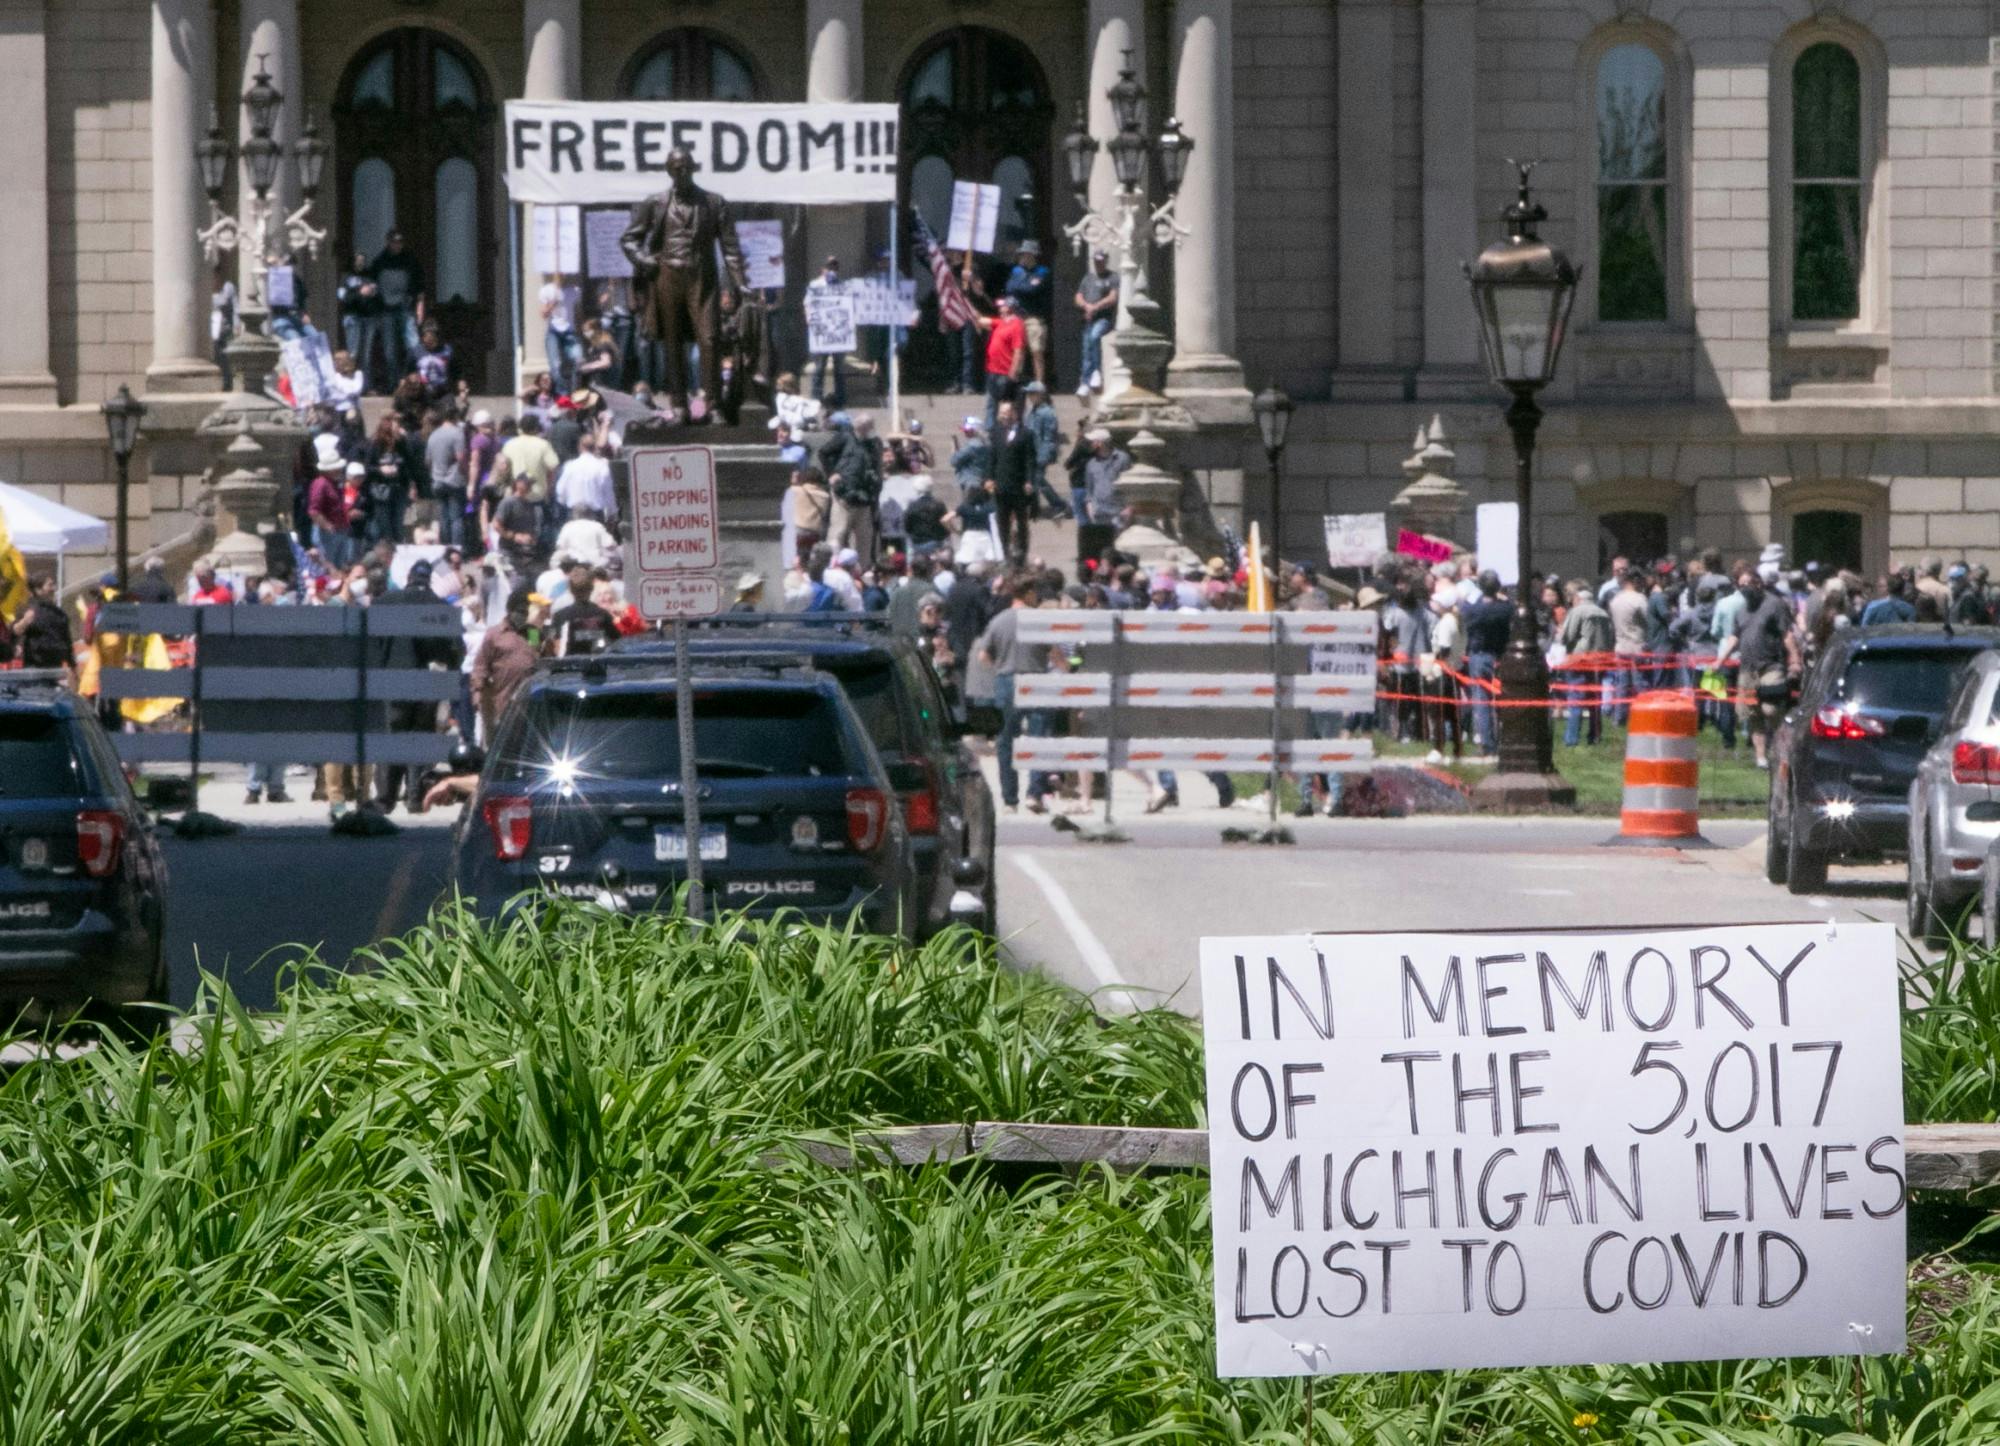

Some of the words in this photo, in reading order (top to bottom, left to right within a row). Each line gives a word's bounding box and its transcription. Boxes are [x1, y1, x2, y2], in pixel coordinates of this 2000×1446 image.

[663, 467, 683, 480] NO
[641, 489, 708, 508] STOPPING
[643, 513, 710, 532] STANDING
[648, 538, 708, 555] PARKING
[665, 600, 697, 610] ZONE
[539, 856, 571, 873] 37
[727, 881, 816, 893] POLICE
[1234, 953, 1335, 1040] IN
[1402, 943, 1816, 1039] MEMORY
[1231, 1062, 1325, 1141] OF
[1381, 1050, 1560, 1136] THE
[1628, 1041, 1843, 1139] 5,017
[1239, 1143, 1641, 1233] MICHIGAN
[1695, 1136, 1906, 1224] LIVES
[1235, 1240, 1411, 1323] LOST
[1442, 1238, 1526, 1316] TO
[1583, 1230, 1808, 1314] COVID
